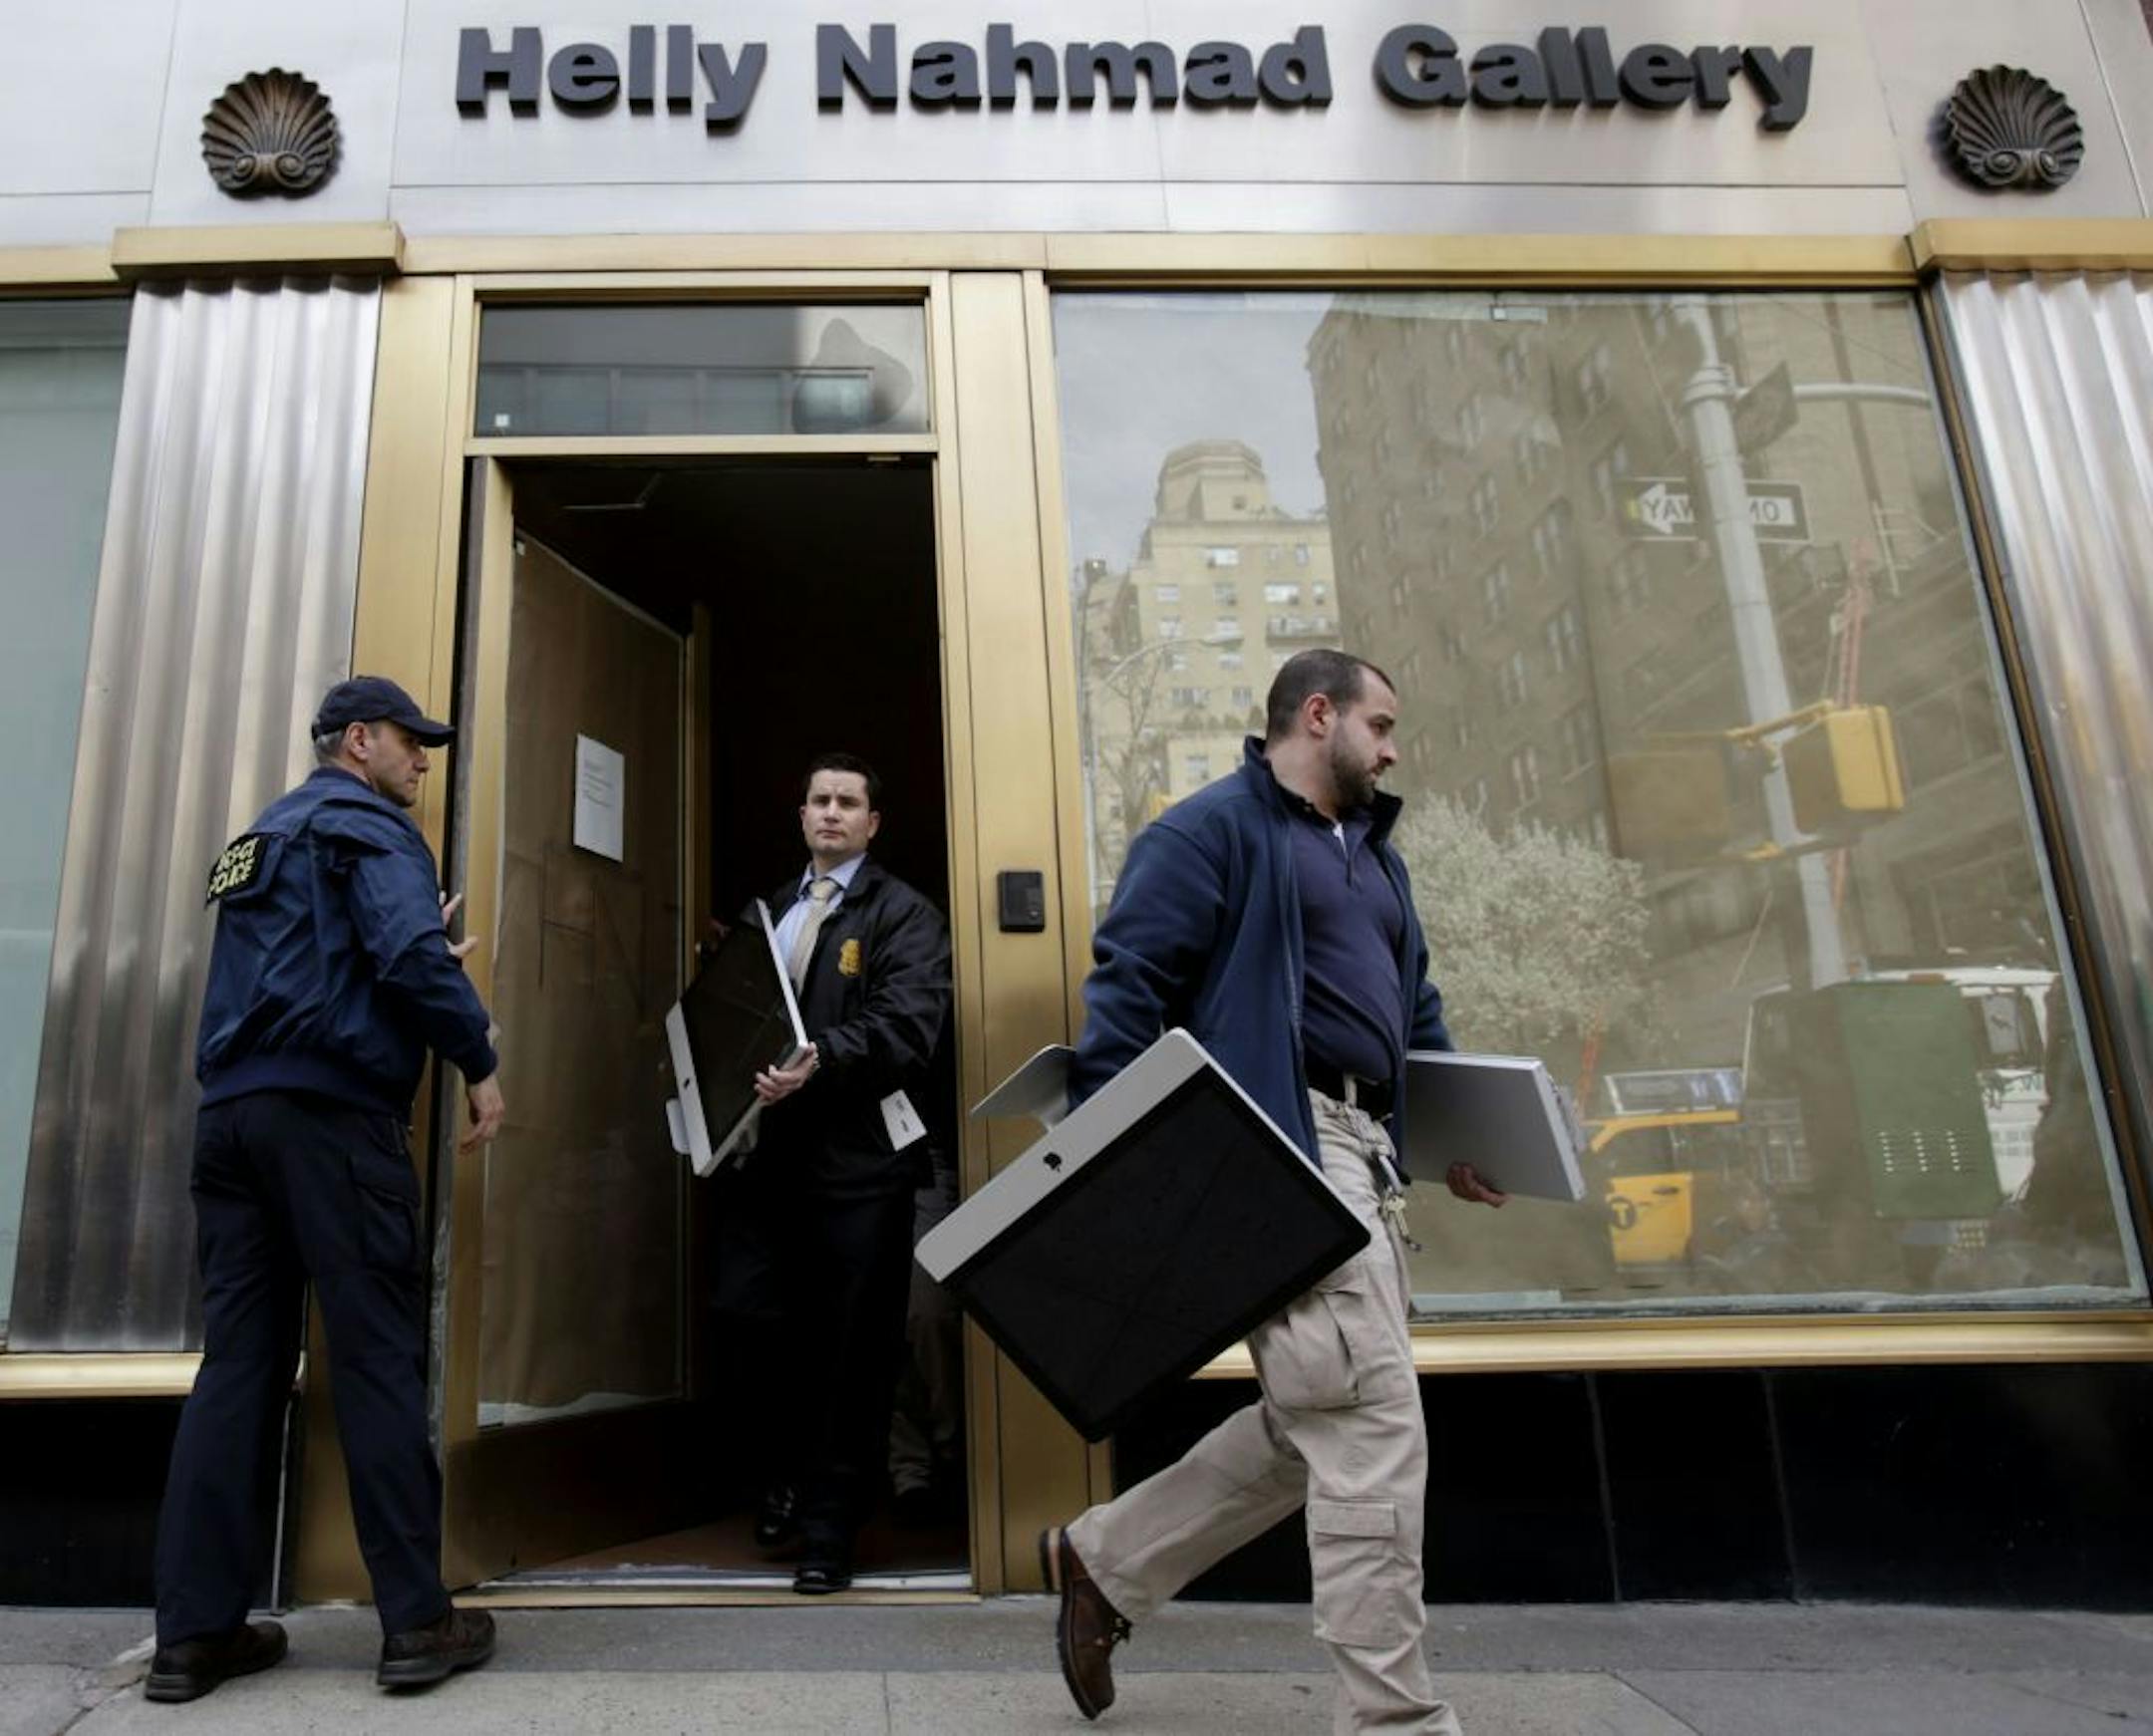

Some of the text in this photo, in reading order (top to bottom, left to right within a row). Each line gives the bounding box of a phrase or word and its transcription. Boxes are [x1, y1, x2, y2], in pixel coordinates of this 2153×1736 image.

[456, 23, 1814, 136] Helly Nahmad Gallery
